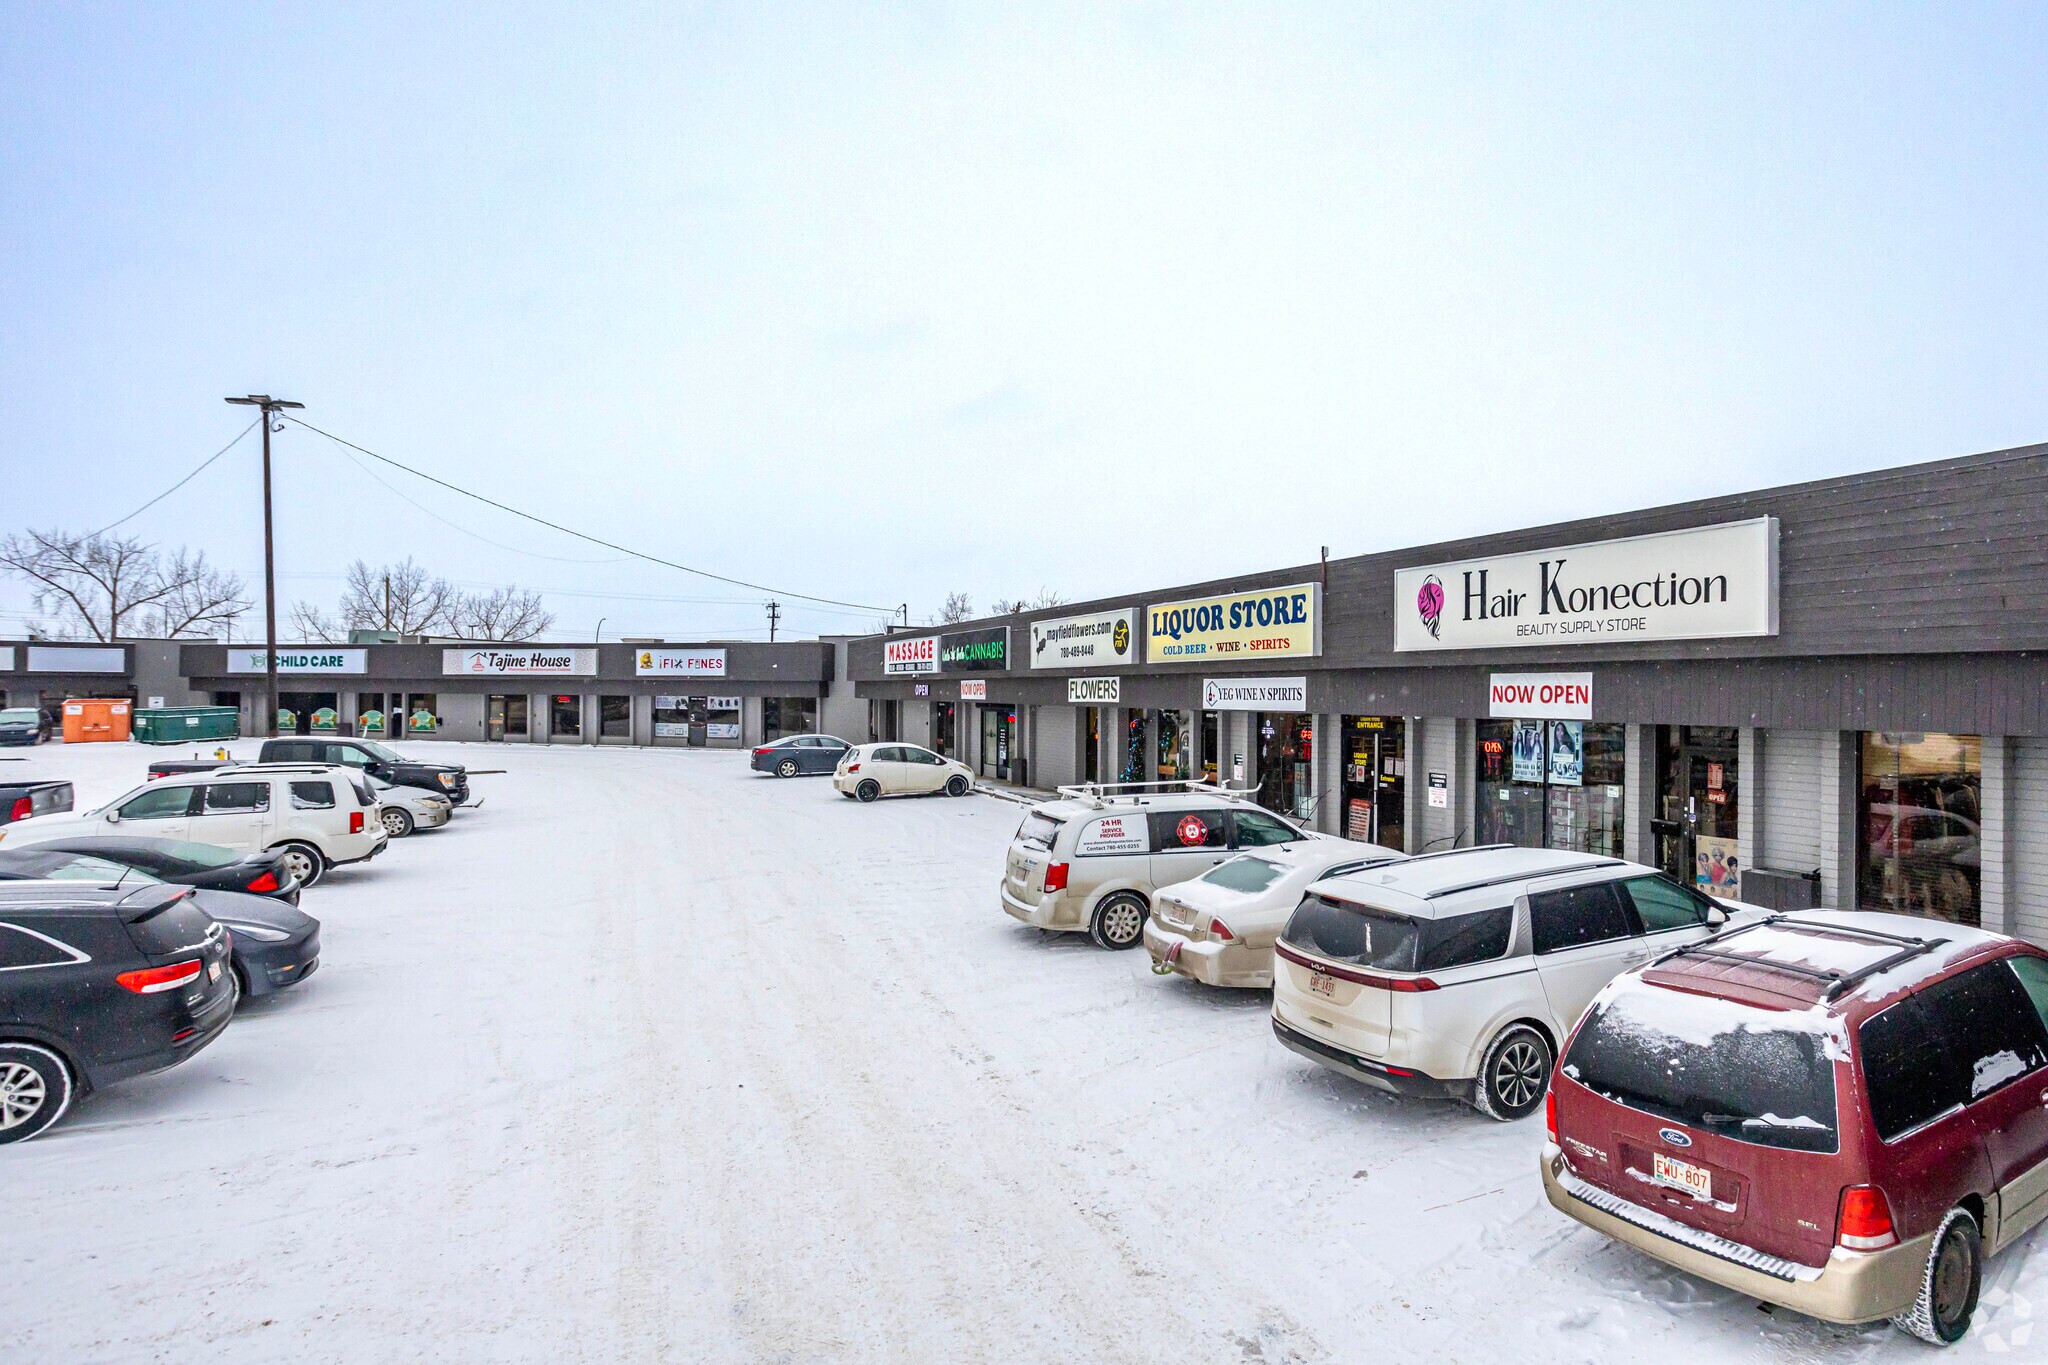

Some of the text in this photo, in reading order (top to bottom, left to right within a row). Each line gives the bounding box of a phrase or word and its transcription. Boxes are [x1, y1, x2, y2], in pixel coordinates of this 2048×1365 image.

[1462, 559, 1728, 621] Hair Konection
[1152, 593, 1307, 640] LIQUOR STORE
[1046, 621, 1112, 643] mayfieldflowers.com
[1516, 617, 1646, 637] BEAUTY SUPPLY STORE
[889, 640, 933, 663] MASSAGE
[965, 641, 1004, 661] CANNABIS
[1163, 637, 1291, 656] COLD BEER WINE SPIRITS
[310, 655, 344, 667] CARE
[489, 652, 571, 671] Tajine House
[914, 684, 929, 696] OPEN
[972, 683, 986, 696] OPEN
[1069, 679, 1118, 700] FLOWERS
[1218, 686, 1303, 701] YEG WINE N SPIRITS
[1492, 685, 1589, 704] NOW OPEN
[1484, 741, 1503, 753] OPEN
[1565, 1136, 1608, 1158] FREESTAR
[1656, 1159, 1707, 1190] EWU-807
[1797, 1219, 1821, 1231] SEL
